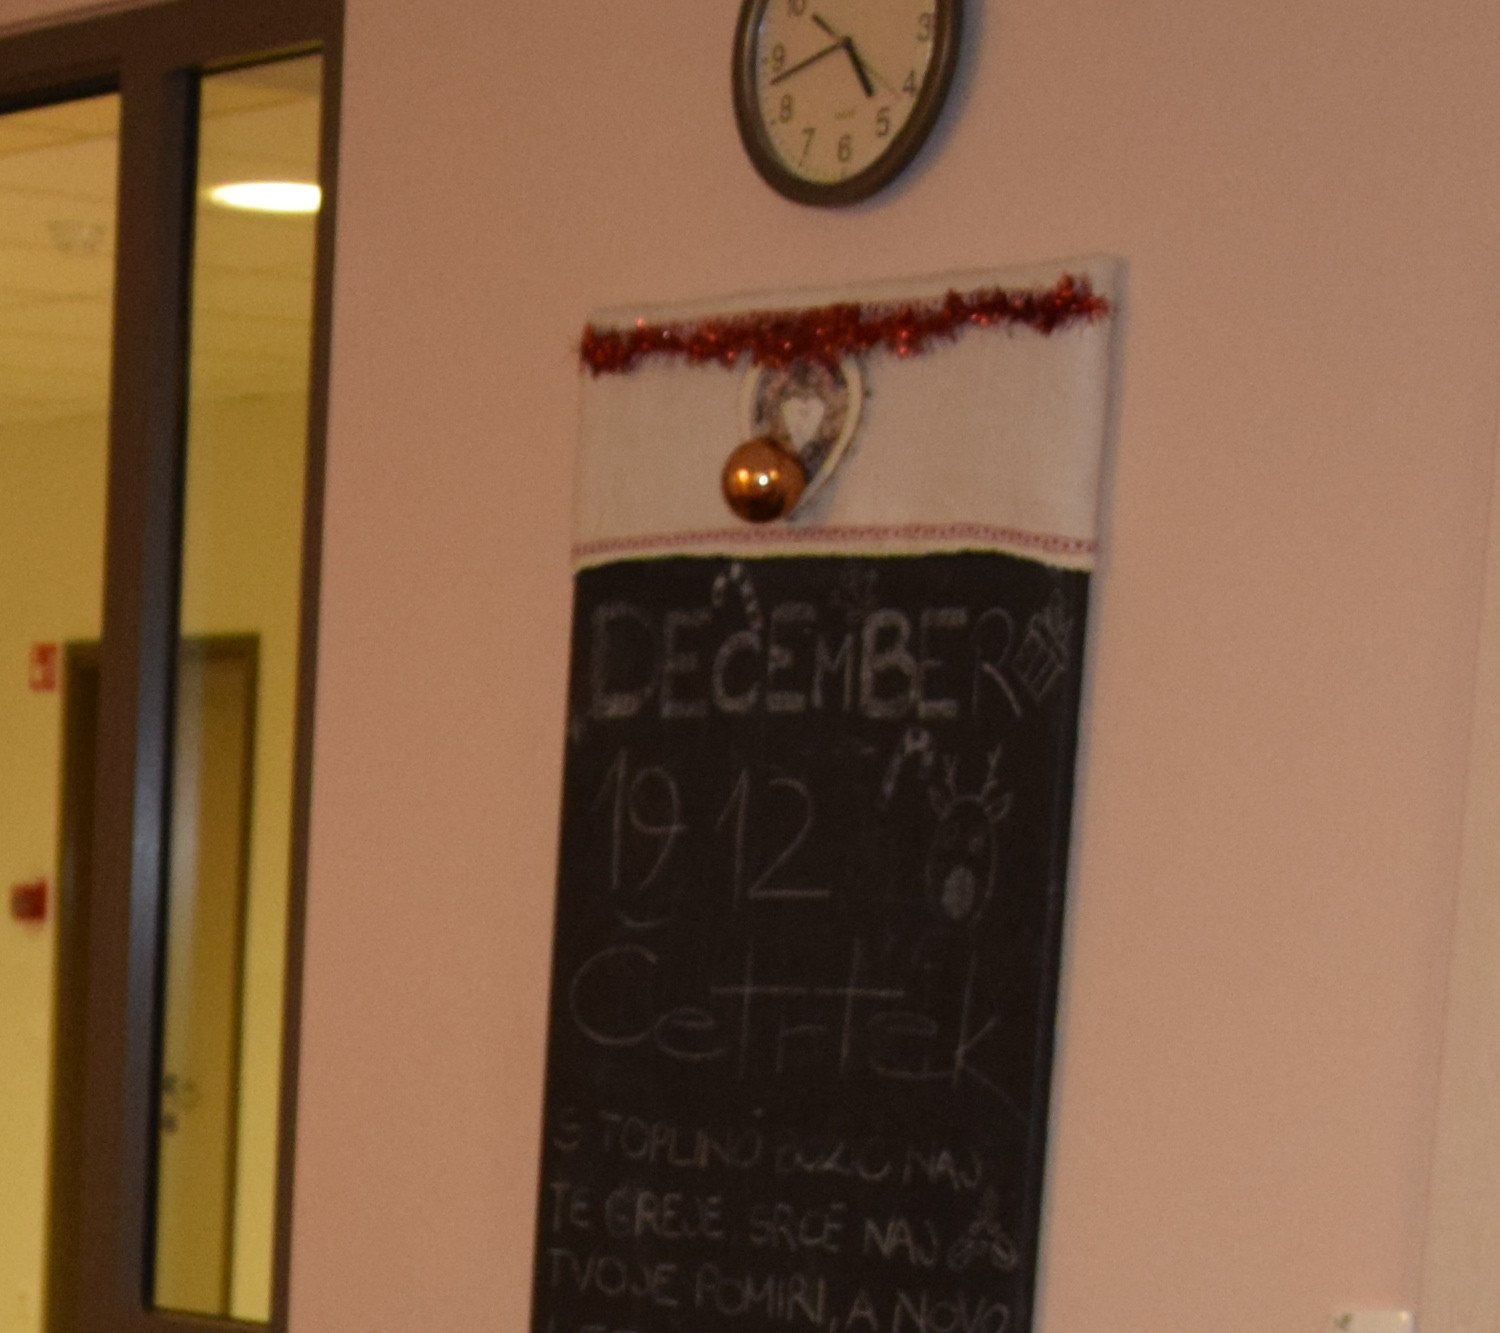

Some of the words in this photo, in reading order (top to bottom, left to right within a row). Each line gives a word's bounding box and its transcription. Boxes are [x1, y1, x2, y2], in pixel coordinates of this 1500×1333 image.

[917, 12, 932, 43] 3
[772, 42, 785, 72] 9
[902, 69, 917, 97] 4
[780, 94, 793, 124] 8
[875, 107, 889, 138] 5
[803, 127, 816, 158] 7
[838, 133, 852, 163] 6
[591, 602, 1022, 720] DECEMBER
[604, 748, 687, 891] 19
[715, 768, 830, 912] 12
[549, 1181, 591, 1233] TE
[749, 1201, 846, 1252] SRCE
[864, 1219, 938, 1267] NAJ
[549, 1247, 678, 1307] TVOJE
[846, 1289, 879, 1331] A
